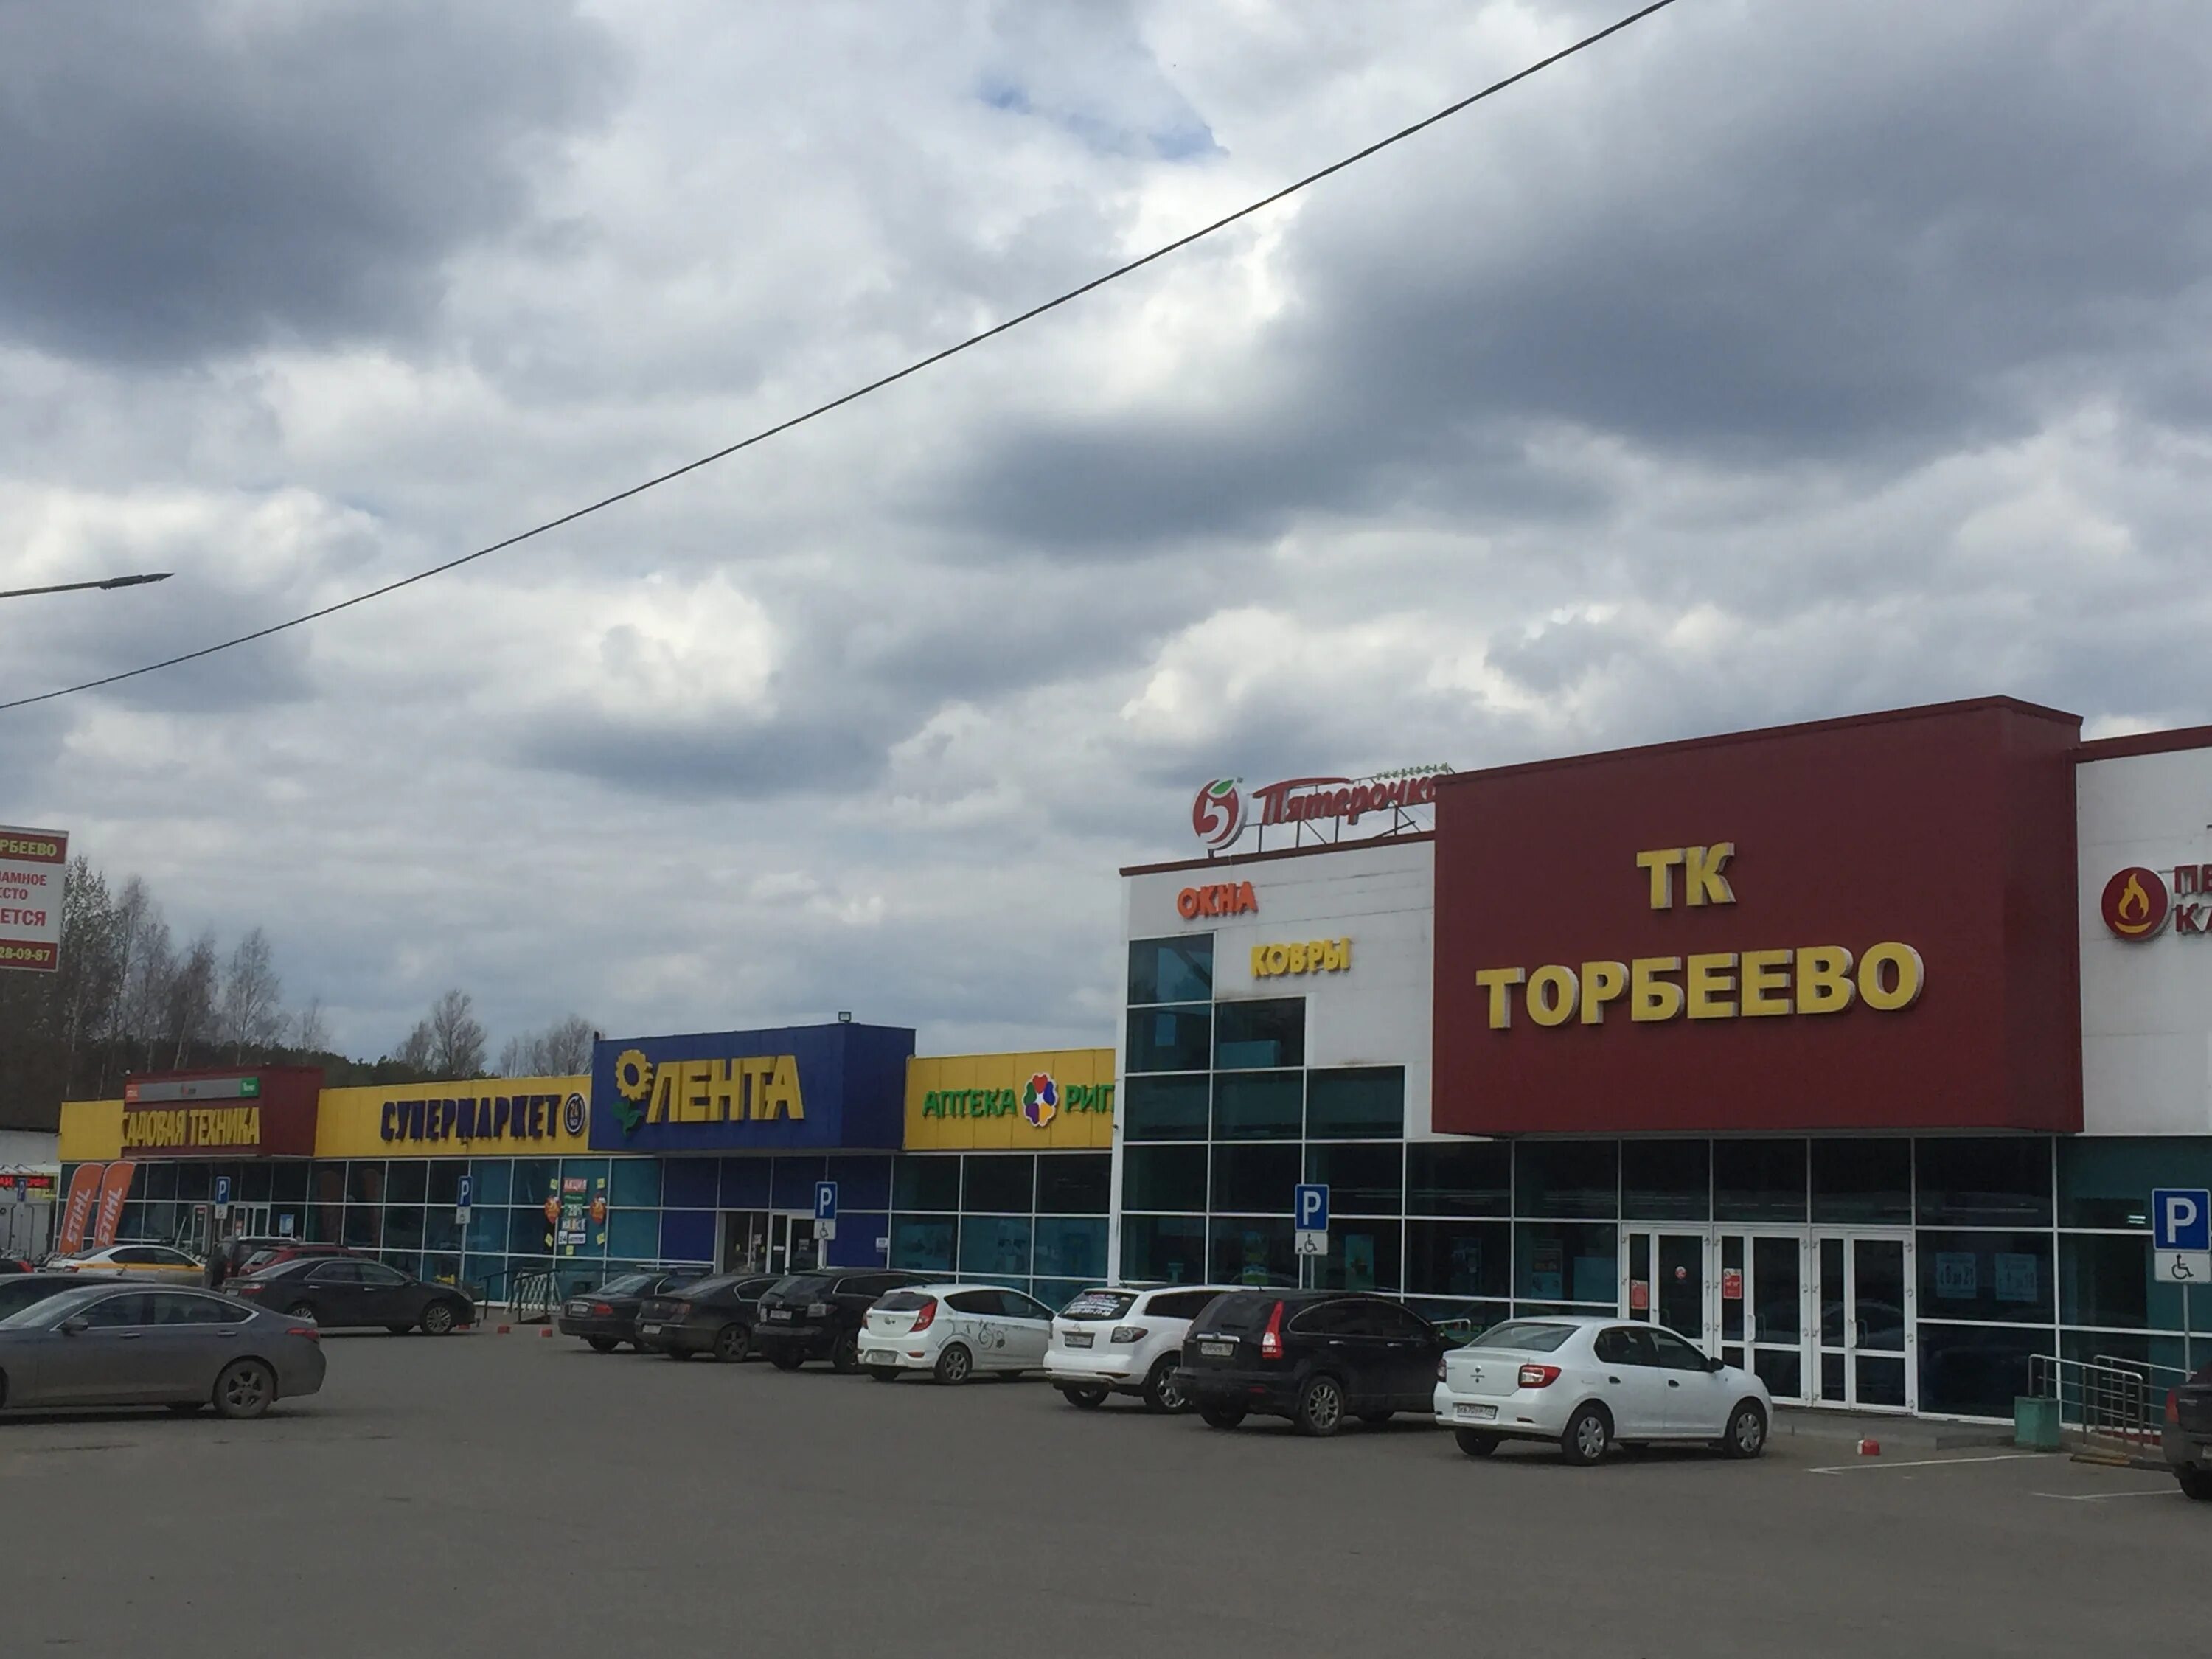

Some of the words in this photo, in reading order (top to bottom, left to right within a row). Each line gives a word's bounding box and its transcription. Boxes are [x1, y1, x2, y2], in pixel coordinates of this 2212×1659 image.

[0, 870, 47, 886] АМНОЕ
[1636, 841, 1736, 910] ТК
[1177, 881, 1258, 919] ОКНА
[1251, 937, 1352, 977] КОВРЫ
[1475, 941, 1925, 1029] ТОРБЕЕВО
[646, 1055, 804, 1124] ЛЕНТА
[922, 1088, 1018, 1119] АПТЕКА
[122, 1110, 187, 1147] САДОВАЯ
[189, 1107, 260, 1146] ТЕХНИКА
[380, 1094, 562, 1142] СУПЕРМАРКЕТ
[218, 1180, 228, 1202] P
[460, 1180, 470, 1203] P
[820, 1187, 832, 1216] P
[1303, 1191, 1321, 1225] P
[67, 1188, 91, 1245] STIHL
[99, 1185, 123, 1245] STIHL
[2166, 1197, 2197, 1244] P
